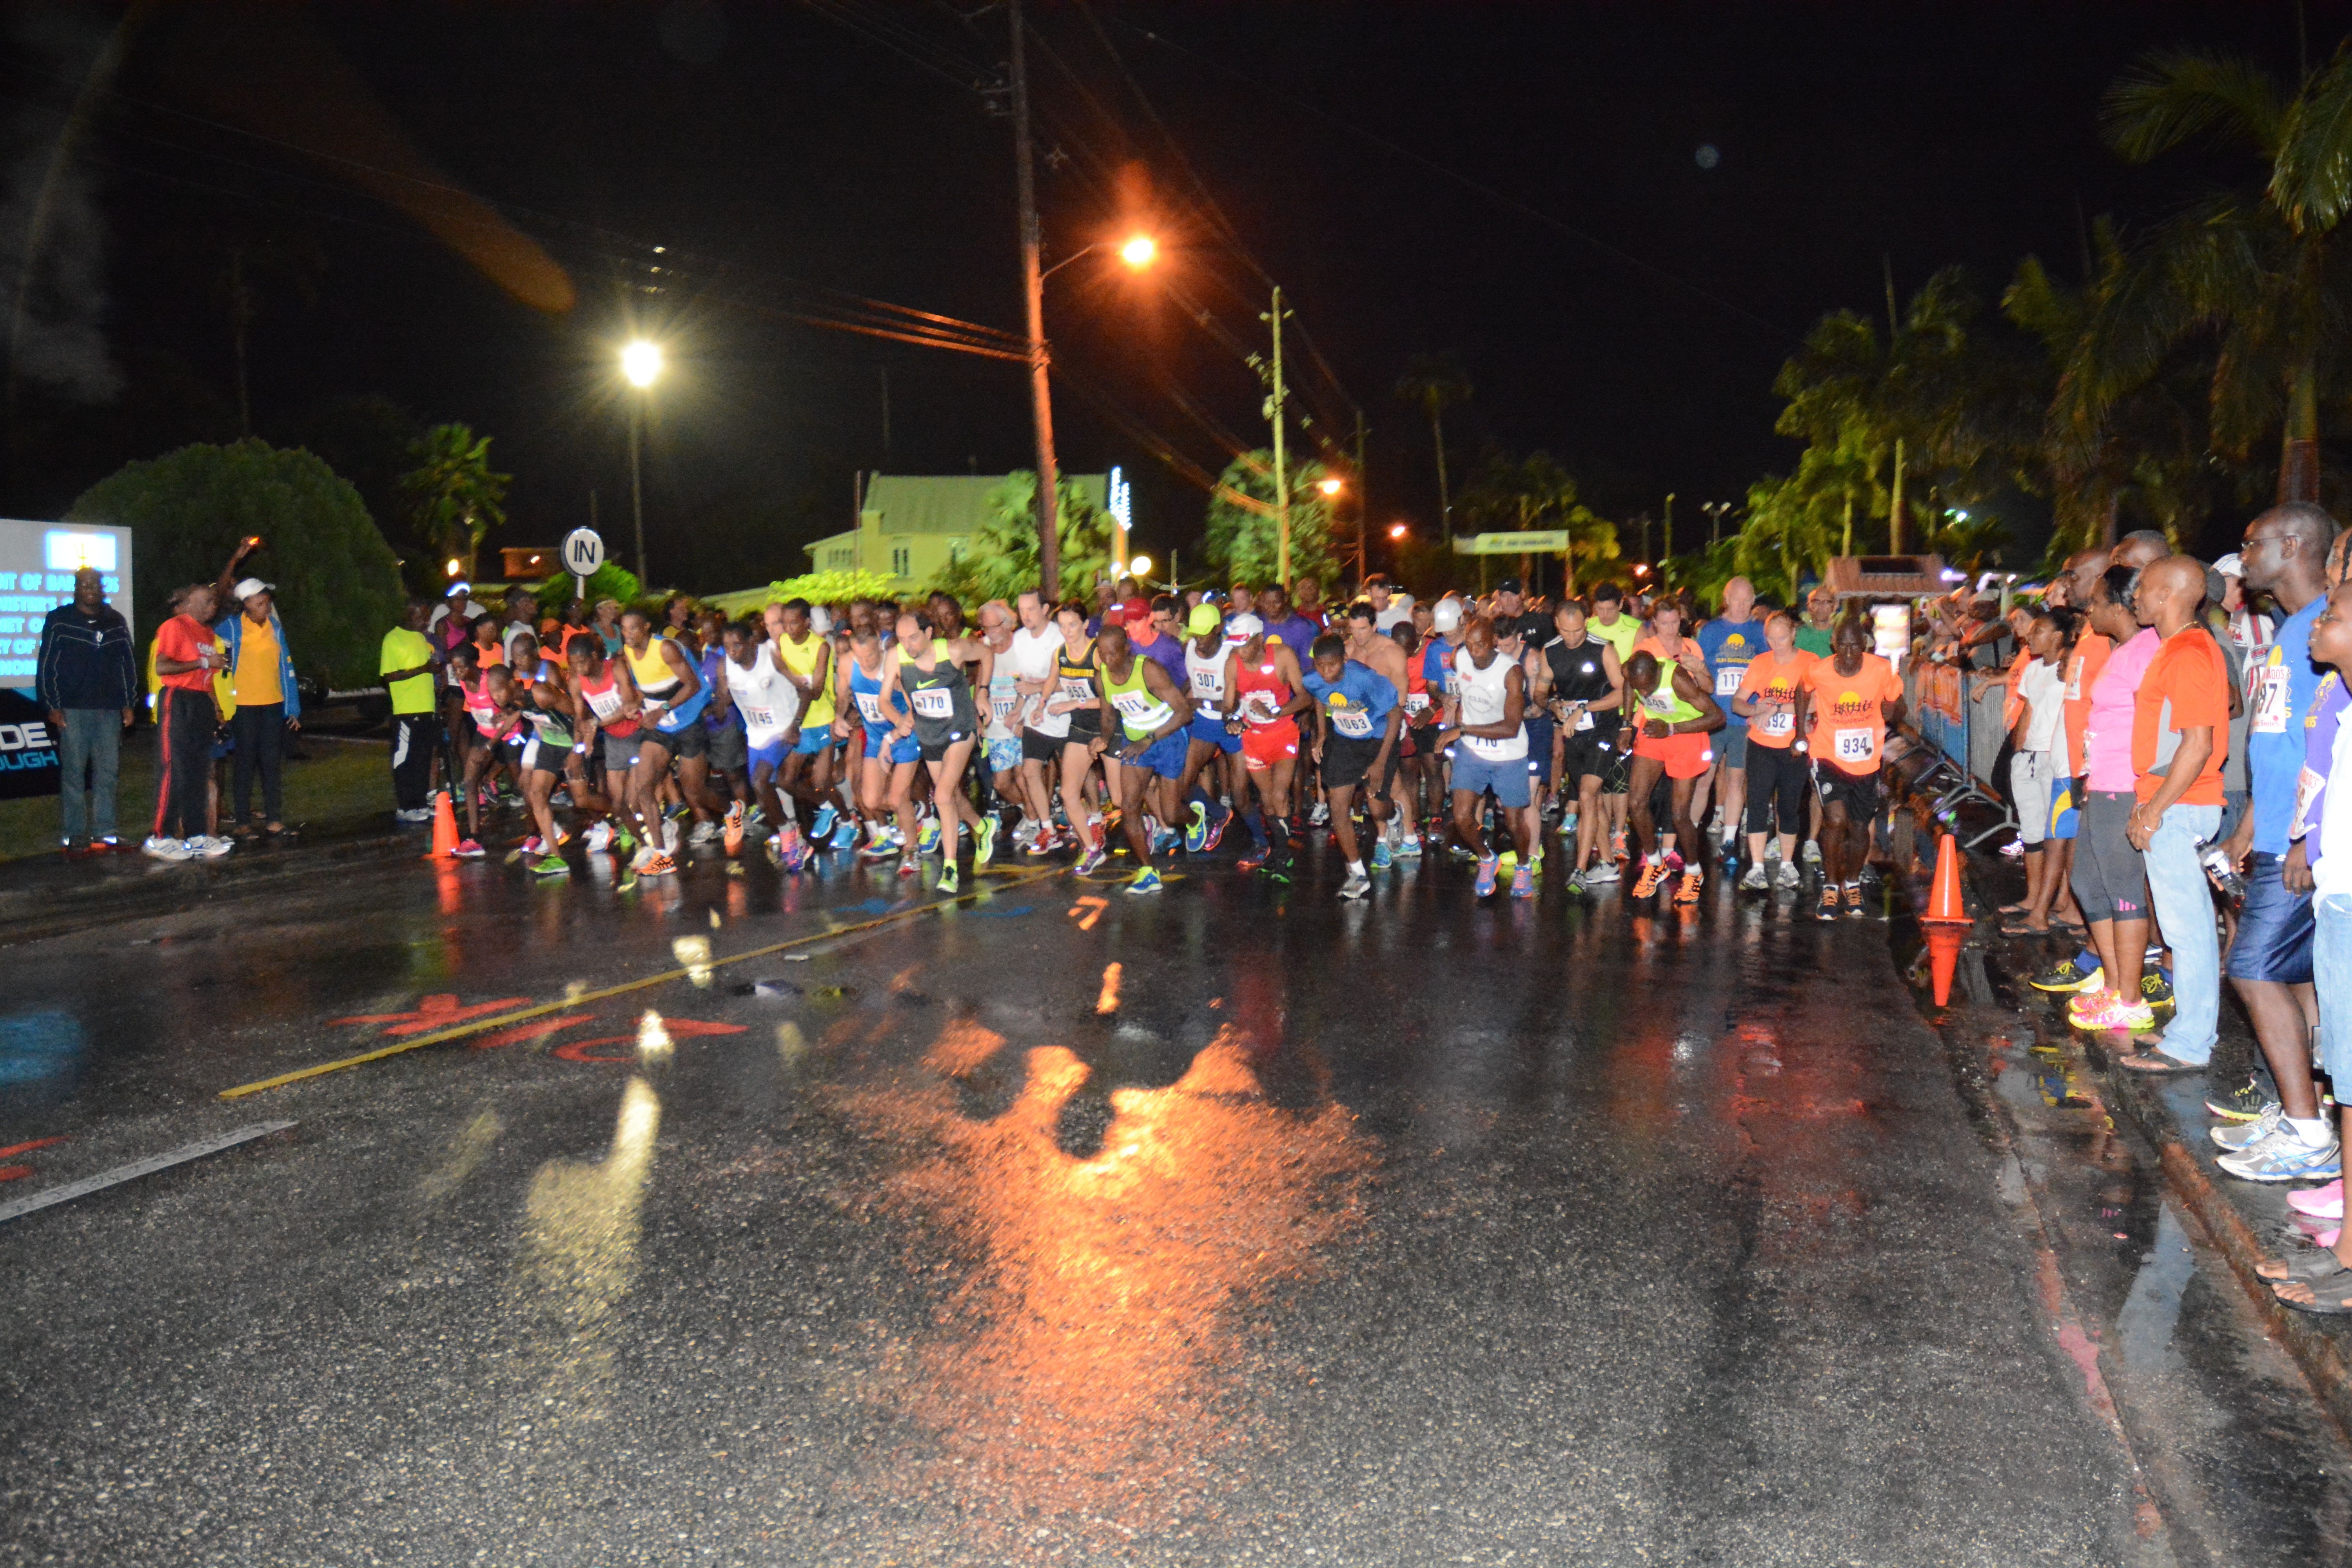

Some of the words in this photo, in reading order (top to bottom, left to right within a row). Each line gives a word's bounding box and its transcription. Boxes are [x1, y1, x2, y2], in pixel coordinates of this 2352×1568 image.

[574, 540, 595, 564] IN
[21, 573, 42, 591] OF
[13, 639, 36, 654] OF
[1197, 673, 1214, 688] 307
[921, 696, 944, 709] 170
[747, 710, 773, 724] 1145
[1337, 719, 1367, 730] 1063
[1843, 737, 1867, 753] 934
